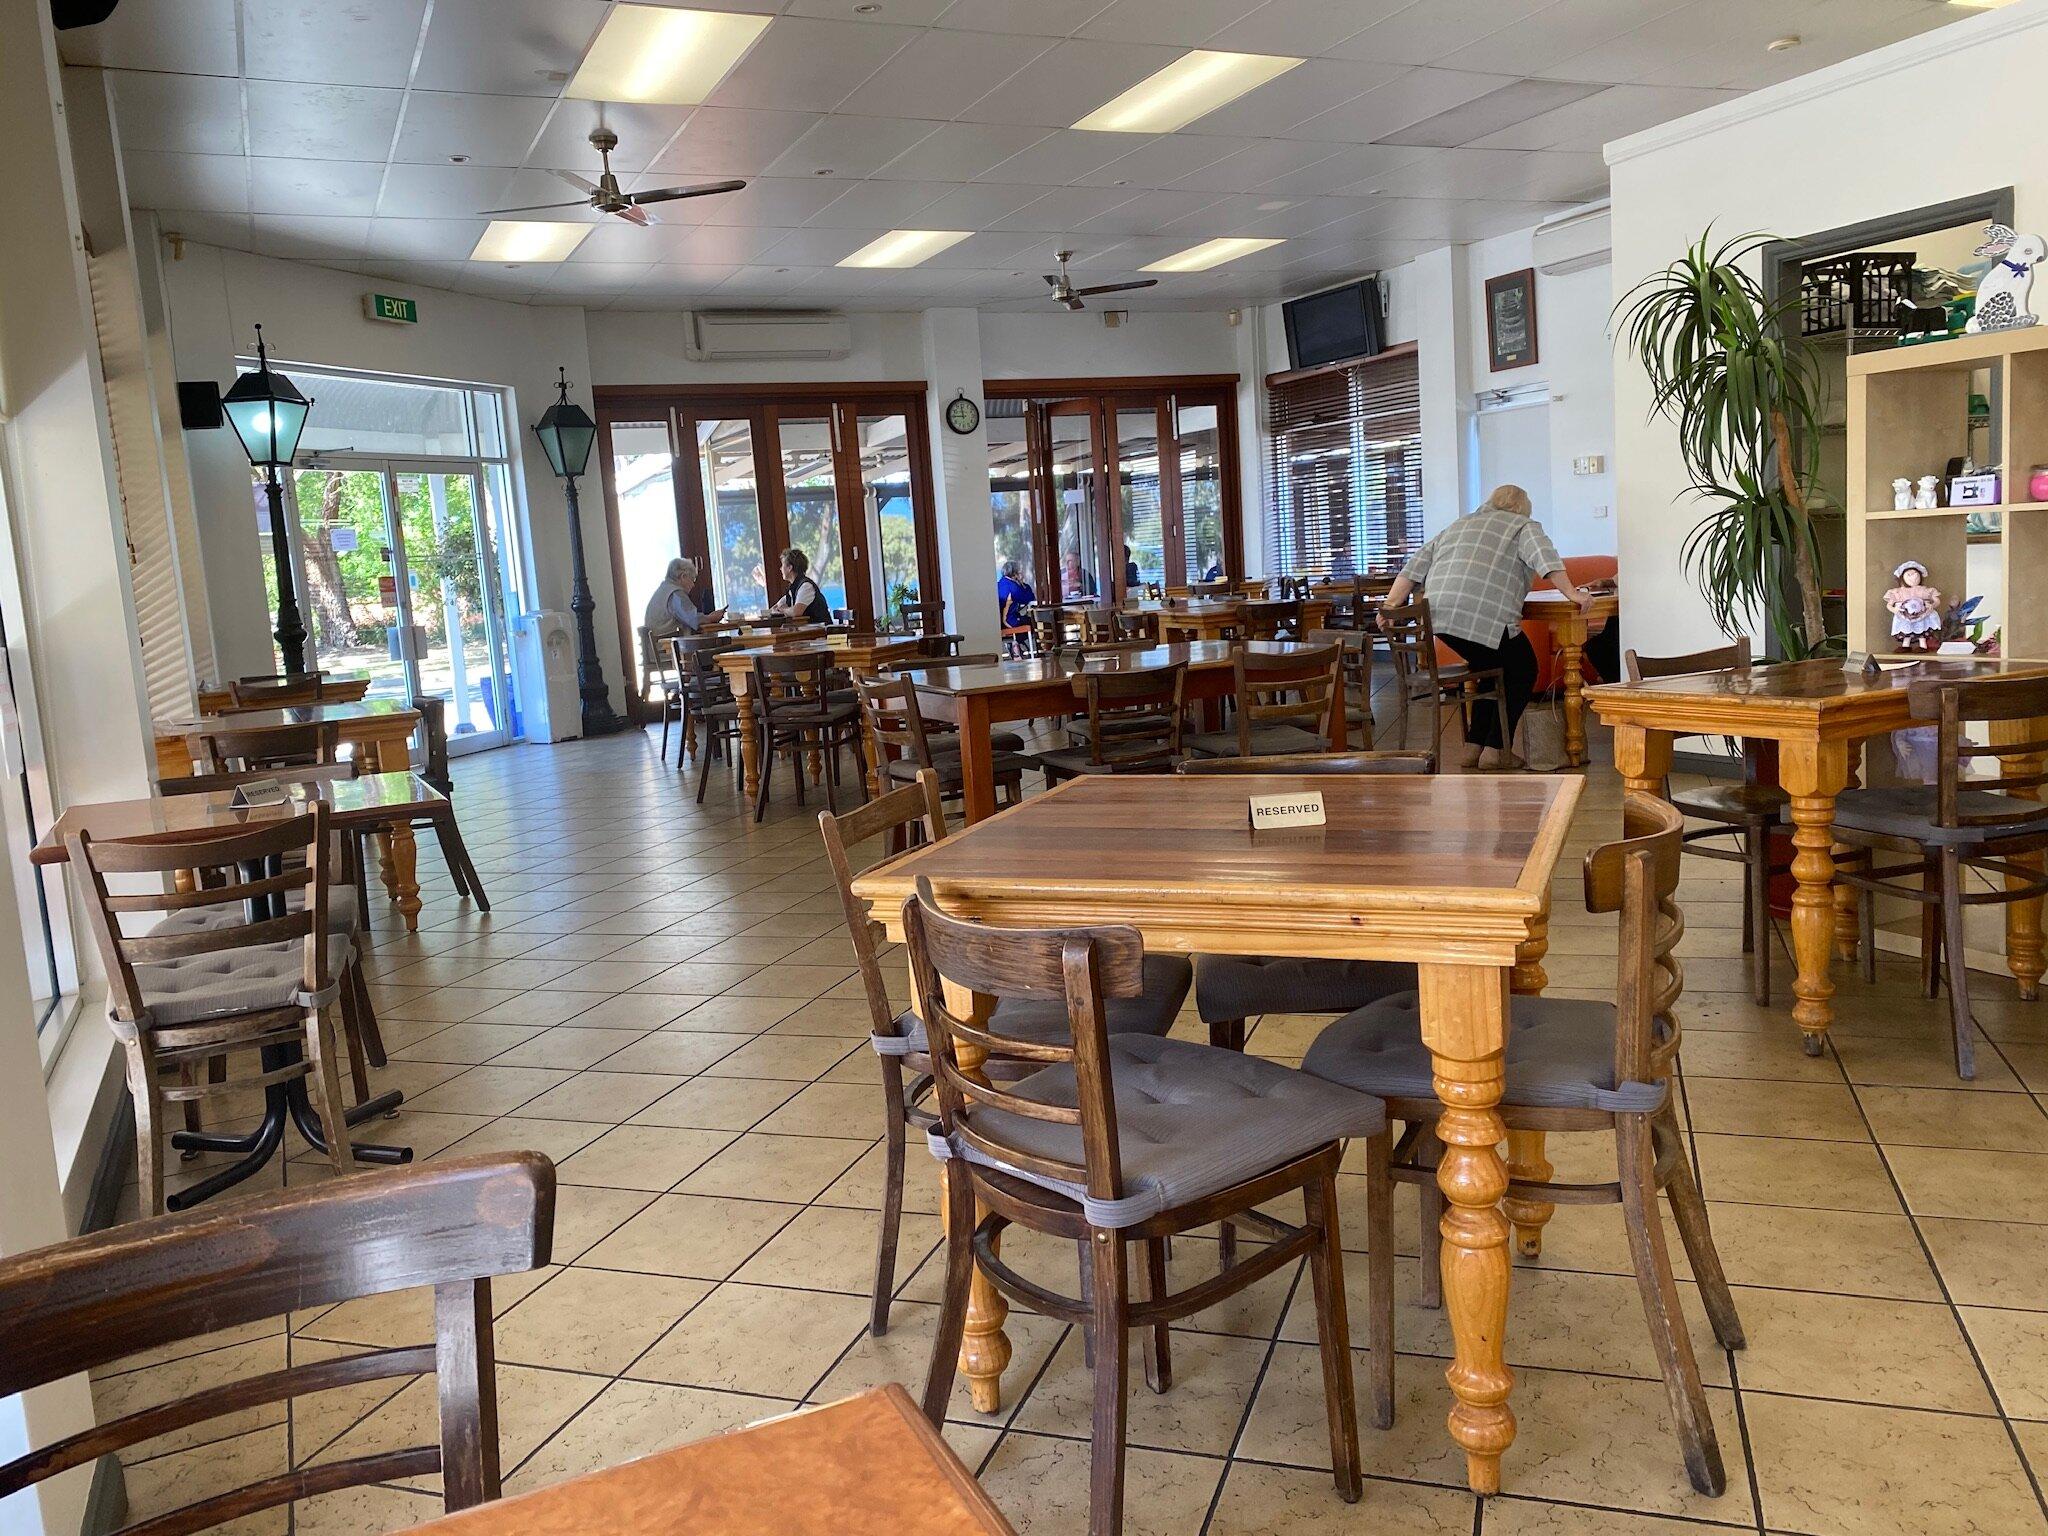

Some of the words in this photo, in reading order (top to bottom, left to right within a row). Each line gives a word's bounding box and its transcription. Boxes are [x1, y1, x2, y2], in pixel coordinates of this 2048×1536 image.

[384, 298, 407, 319] EXIT
[246, 786, 280, 797] RESERVED
[1256, 803, 1319, 817] RESERVED
